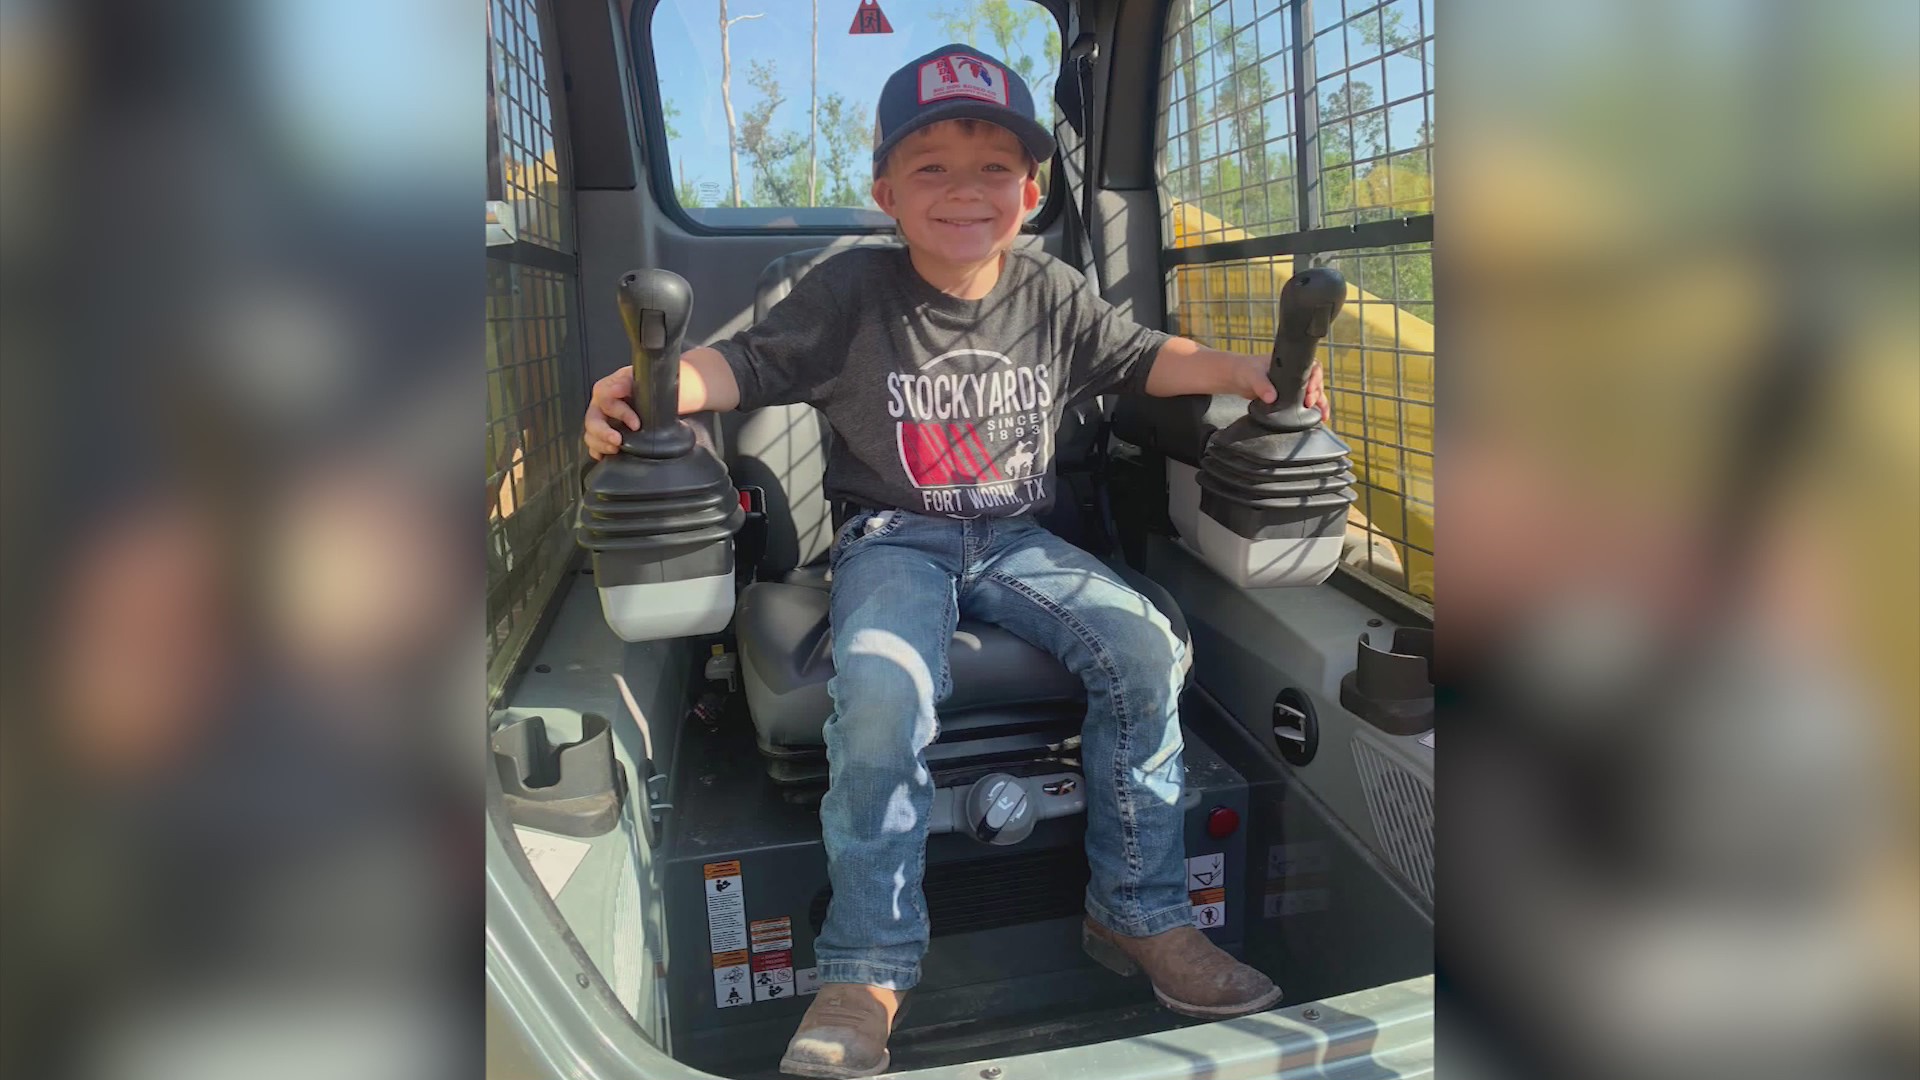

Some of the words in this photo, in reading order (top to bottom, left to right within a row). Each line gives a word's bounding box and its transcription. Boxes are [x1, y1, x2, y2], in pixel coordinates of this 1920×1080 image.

[887, 363, 1051, 420] STOCKYARDS
[987, 412, 1040, 431] SINCE
[987, 424, 1041, 442] 1893
[921, 488, 963, 512] FORT
[967, 484, 1024, 509] WORTH,
[1024, 478, 1047, 501] TX
